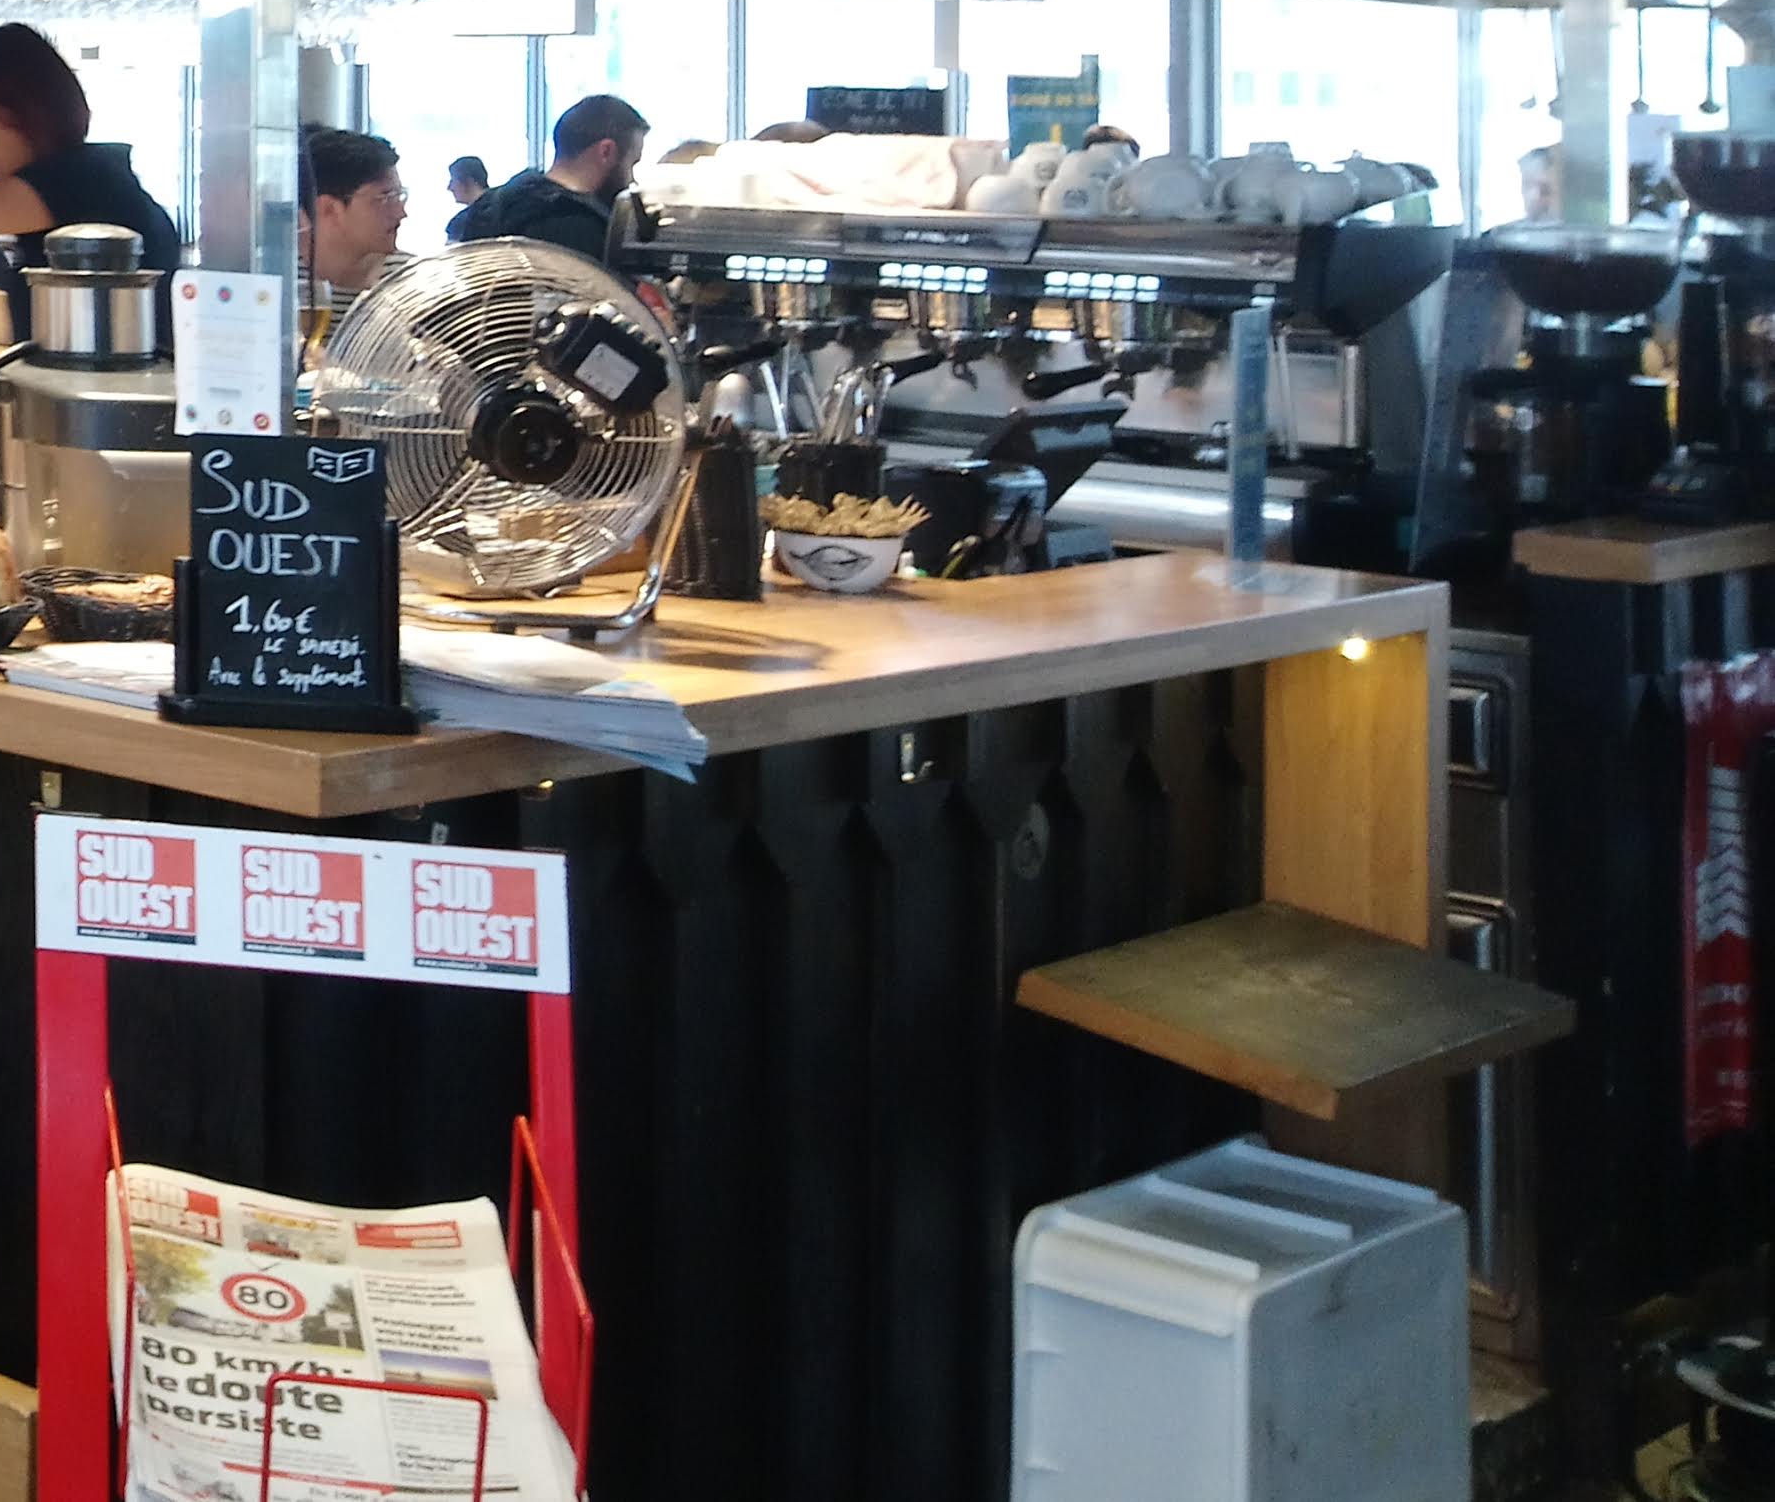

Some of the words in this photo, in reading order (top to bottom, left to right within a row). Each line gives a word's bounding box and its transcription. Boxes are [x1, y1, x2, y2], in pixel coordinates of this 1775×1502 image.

[196, 447, 310, 521] SUD
[207, 526, 360, 577] OUEST
[78, 832, 154, 882] SUD
[243, 847, 322, 897] SUD
[78, 879, 194, 930] OUEST
[413, 862, 494, 913] SUD
[243, 893, 362, 946] OUEST
[414, 909, 535, 962] OUEST
[238, 1284, 289, 1311] 80
[141, 1335, 198, 1366] 80
